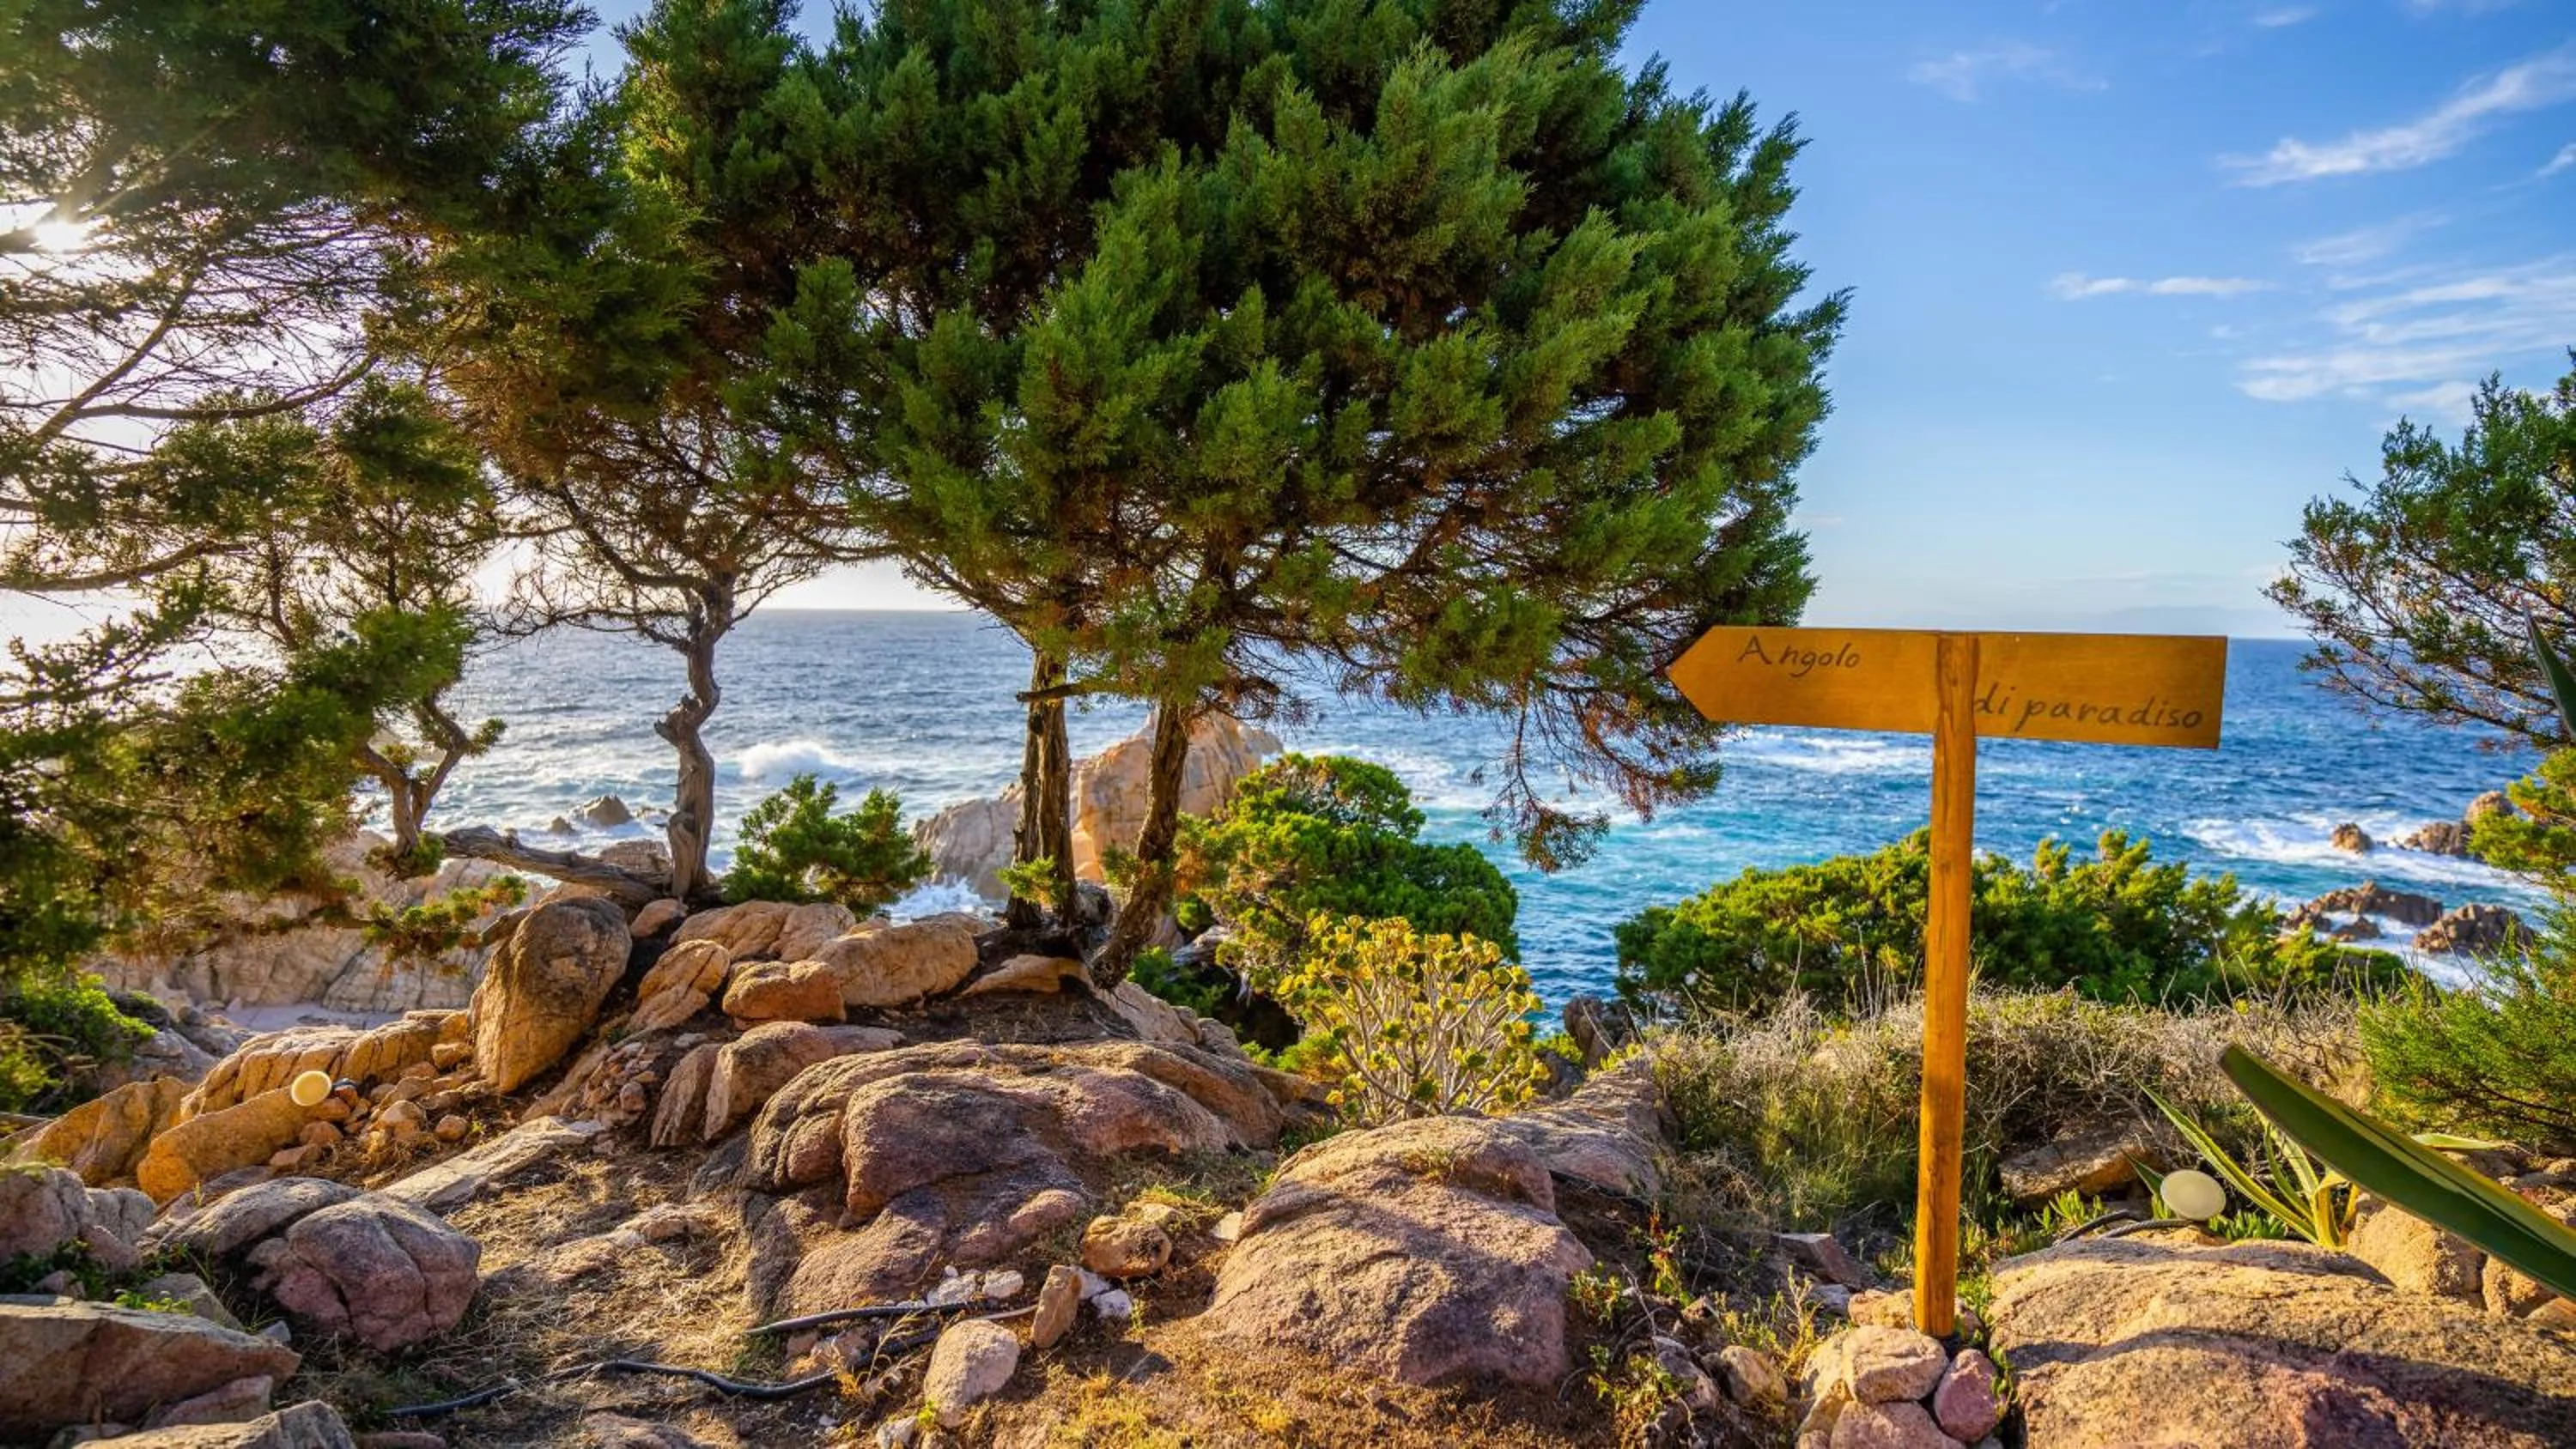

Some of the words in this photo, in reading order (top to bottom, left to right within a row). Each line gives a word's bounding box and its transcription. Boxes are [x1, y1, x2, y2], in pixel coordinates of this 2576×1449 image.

[1736, 634, 1862, 678] Angolo
[1974, 682, 2016, 715] di
[2014, 696, 2203, 732] paradiso
